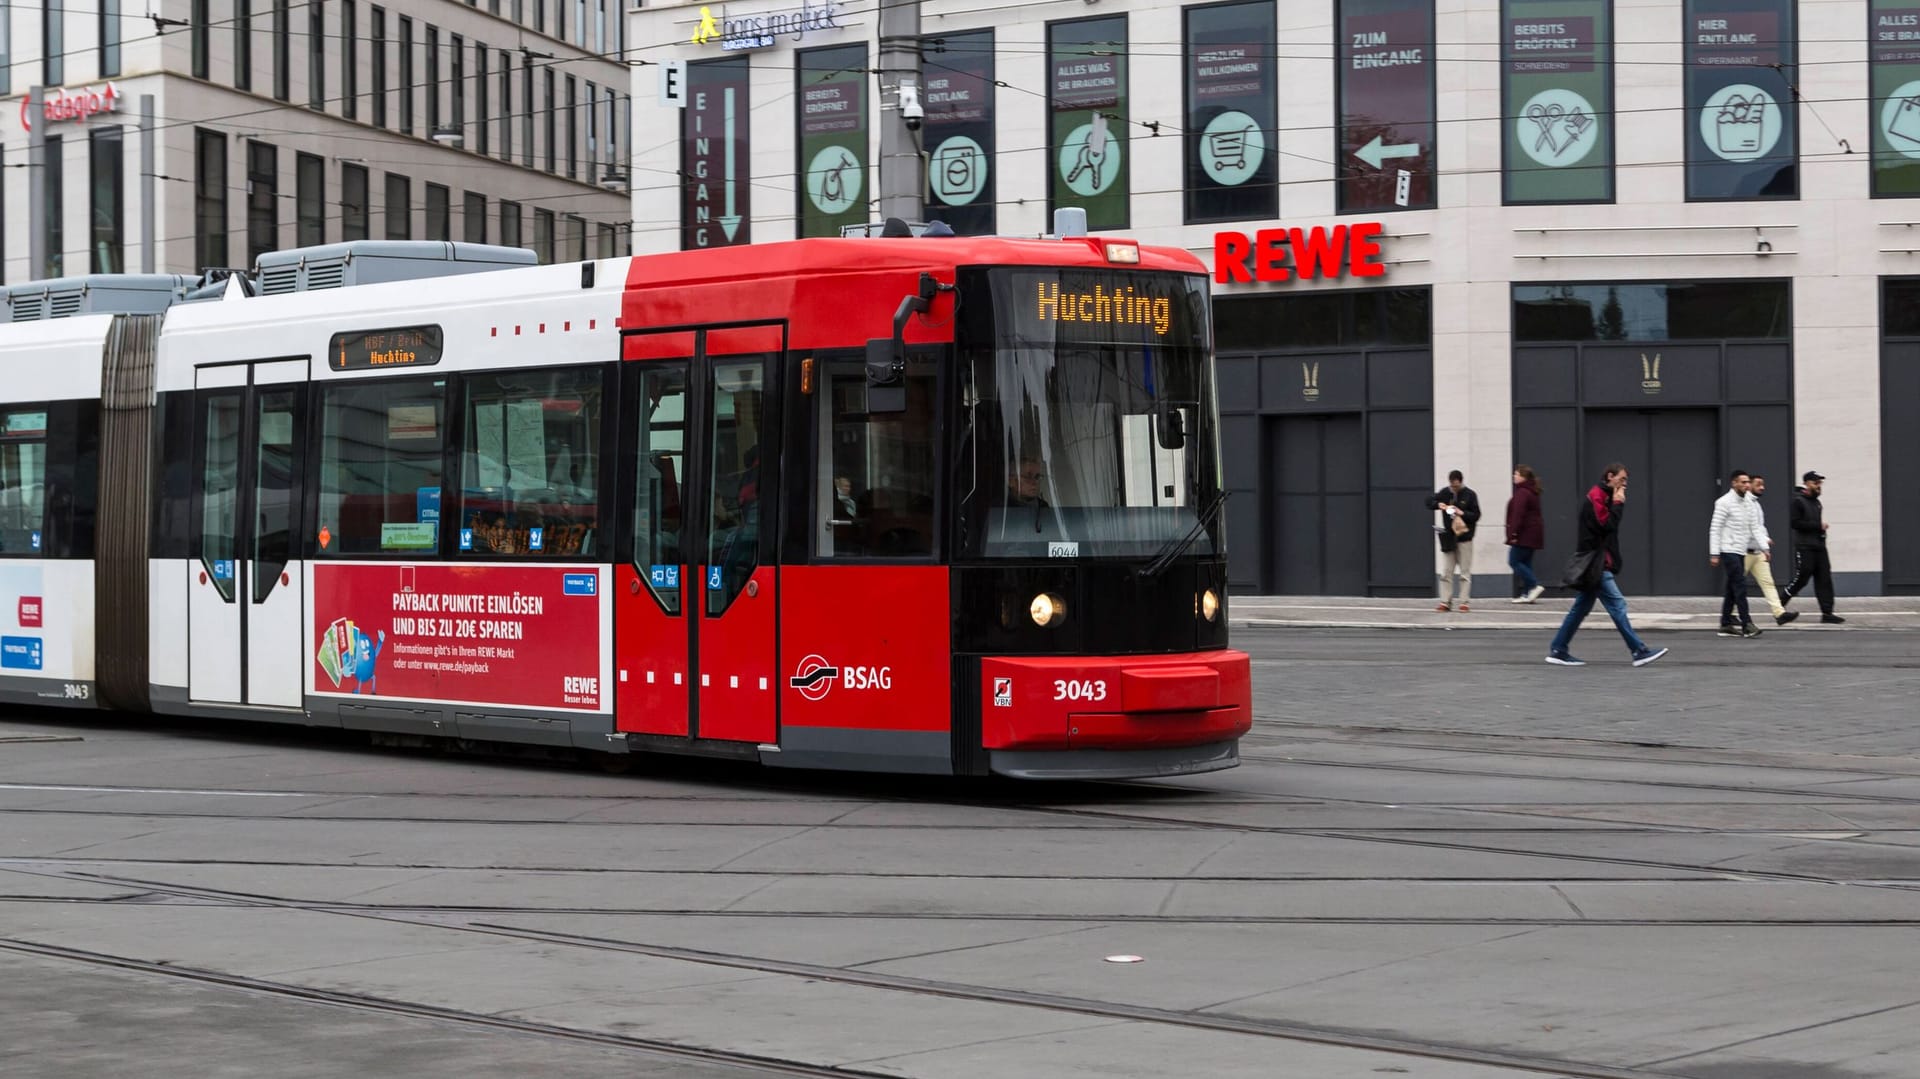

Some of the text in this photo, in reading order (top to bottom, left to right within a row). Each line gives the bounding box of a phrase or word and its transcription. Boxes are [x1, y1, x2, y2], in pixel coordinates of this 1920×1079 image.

[1698, 19, 1728, 30] HIER
[1878, 15, 1918, 26] ALLES
[1514, 23, 1565, 35] BEREITS
[1353, 31, 1387, 48] ZUM
[1514, 37, 1578, 50] ERÖFFNET
[1698, 33, 1757, 45] ENTLANG
[1353, 49, 1422, 69] EINGANG
[1058, 62, 1111, 76] ALLES WAS
[1198, 63, 1258, 76] WILLKOMMEN
[667, 68, 678, 99] E
[928, 79, 949, 89] HIER
[1058, 77, 1115, 90] SIE BRAUCHEN
[805, 89, 840, 100] BEREITS
[928, 90, 969, 103] ENTLANG
[44, 87, 99, 125] adagio
[805, 101, 848, 113] ERÖFFNET
[696, 93, 709, 246] EINGANG
[1214, 222, 1385, 284] REWE
[1038, 282, 1169, 335] Huchting
[370, 349, 416, 365] Huchting
[1052, 546, 1077, 558] 6044
[393, 591, 543, 615] PAYBACK PUNKTE EINLÖSEN
[393, 617, 522, 640] UND BIS ZU 20€ SPAREN
[393, 642, 515, 659] Informationen gibt's in Ihrem REWE Markt
[393, 657, 489, 675] oder unter www.rewe.de/payback
[564, 676, 598, 695] REWE
[844, 666, 892, 690] BSAG
[64, 683, 89, 699] 3043
[1053, 679, 1107, 701] 3043
[564, 694, 598, 705] Besser leben.
[995, 698, 1011, 706] VBN
